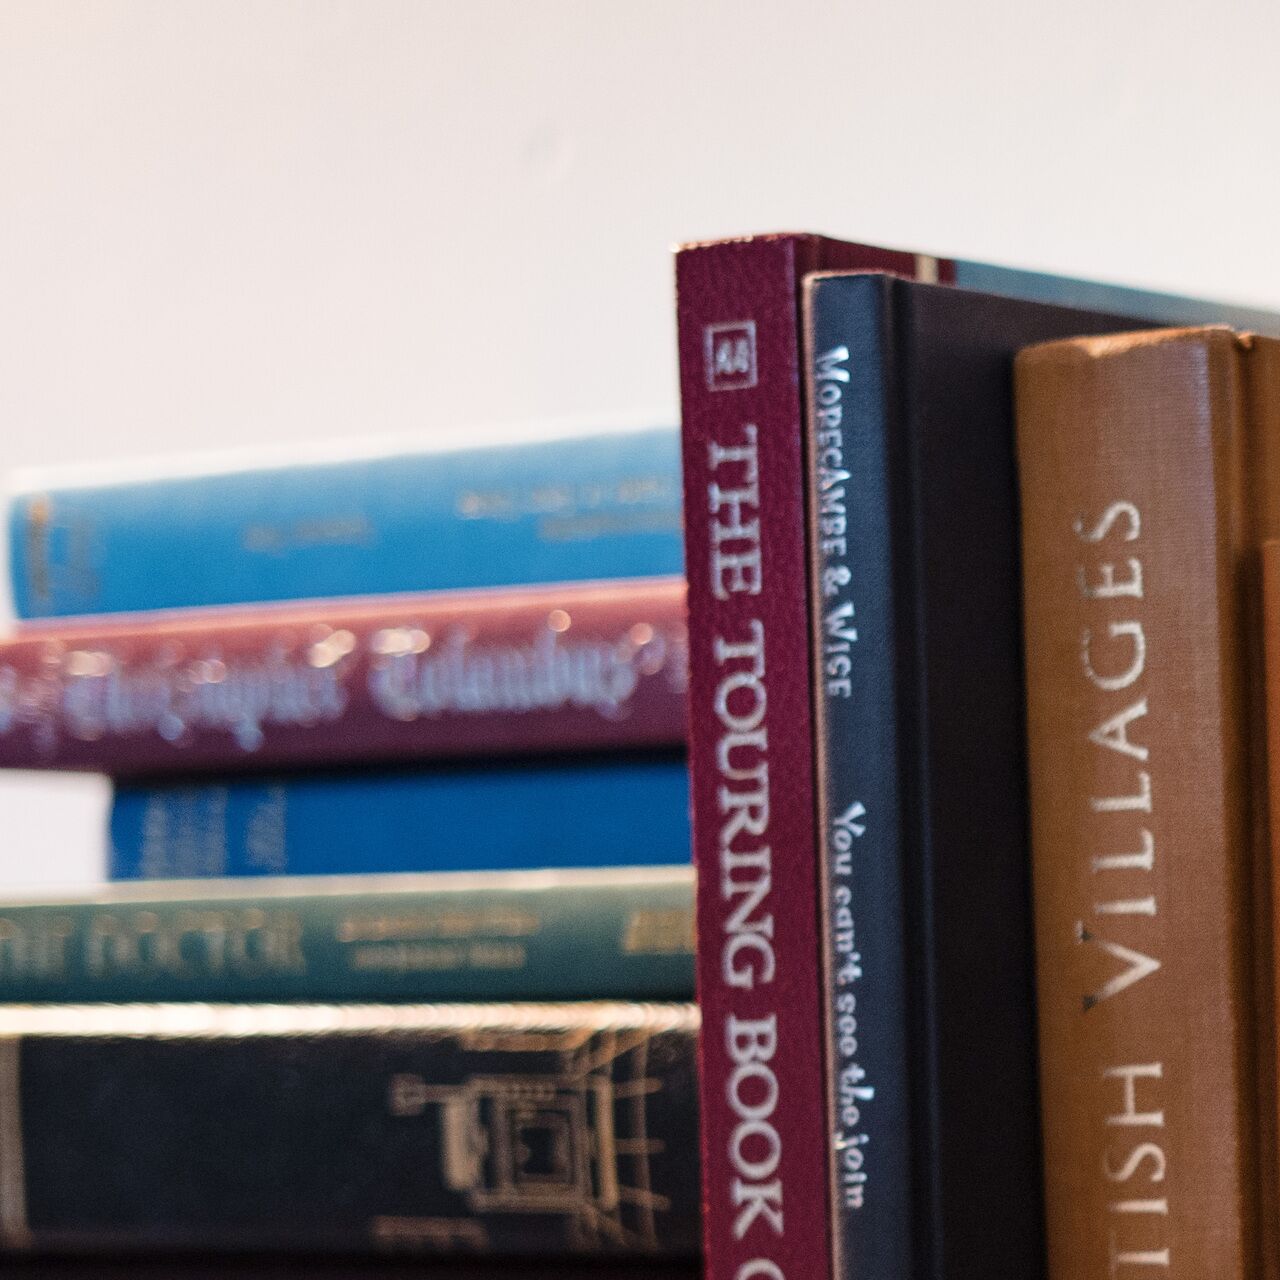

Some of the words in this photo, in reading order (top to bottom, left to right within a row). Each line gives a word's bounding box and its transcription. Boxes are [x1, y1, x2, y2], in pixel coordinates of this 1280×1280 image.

[707, 423, 762, 599] THE
[822, 565, 852, 596] &
[1074, 501, 1162, 1013] VILLAGES
[712, 618, 777, 991] TOURING
[834, 801, 866, 877] You
[836, 885, 862, 985] can't
[837, 992, 858, 1057] see
[725, 1013, 786, 1240] BOOK
[840, 1065, 875, 1128] the
[833, 1131, 870, 1210] join
